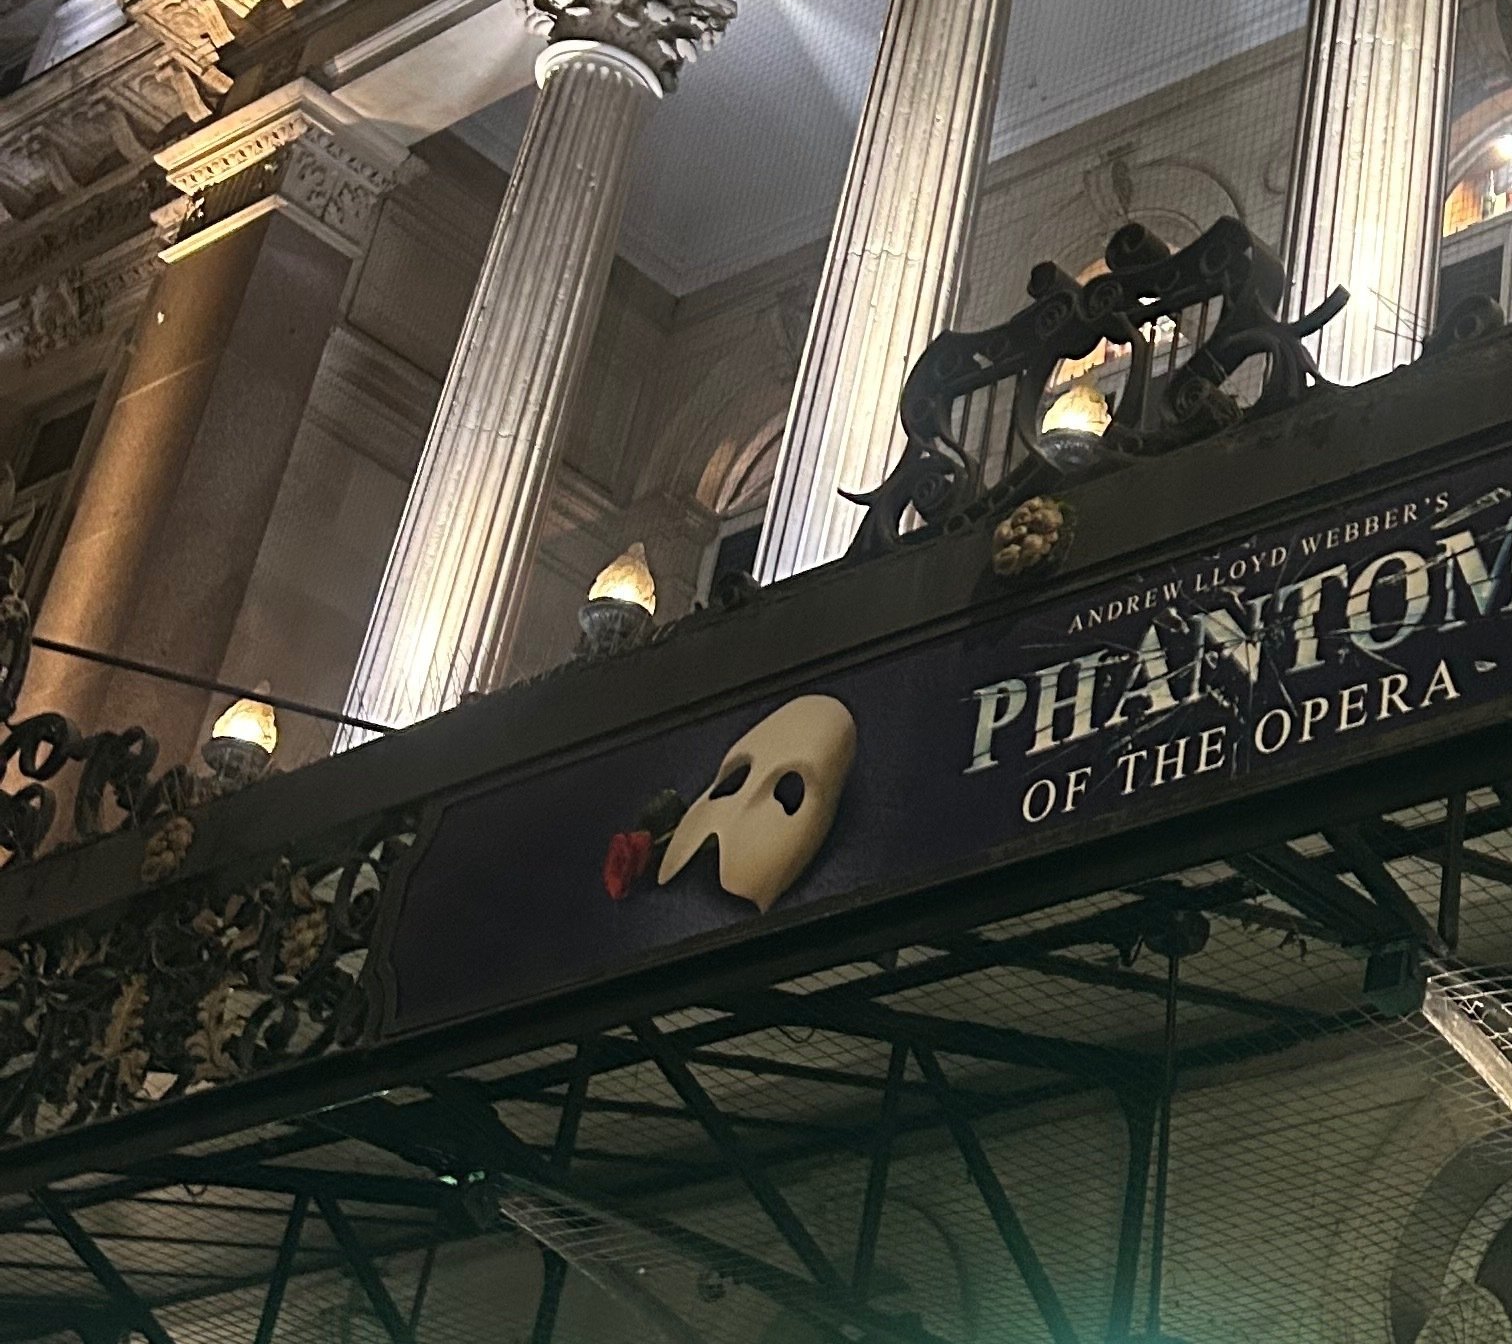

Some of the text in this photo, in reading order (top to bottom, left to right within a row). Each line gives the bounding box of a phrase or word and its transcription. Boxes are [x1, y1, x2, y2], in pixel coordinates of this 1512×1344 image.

[1068, 491, 1450, 635] ANDREW LLOYD WEBBER'S
[1021, 659, 1462, 824] OF THE OPERA
